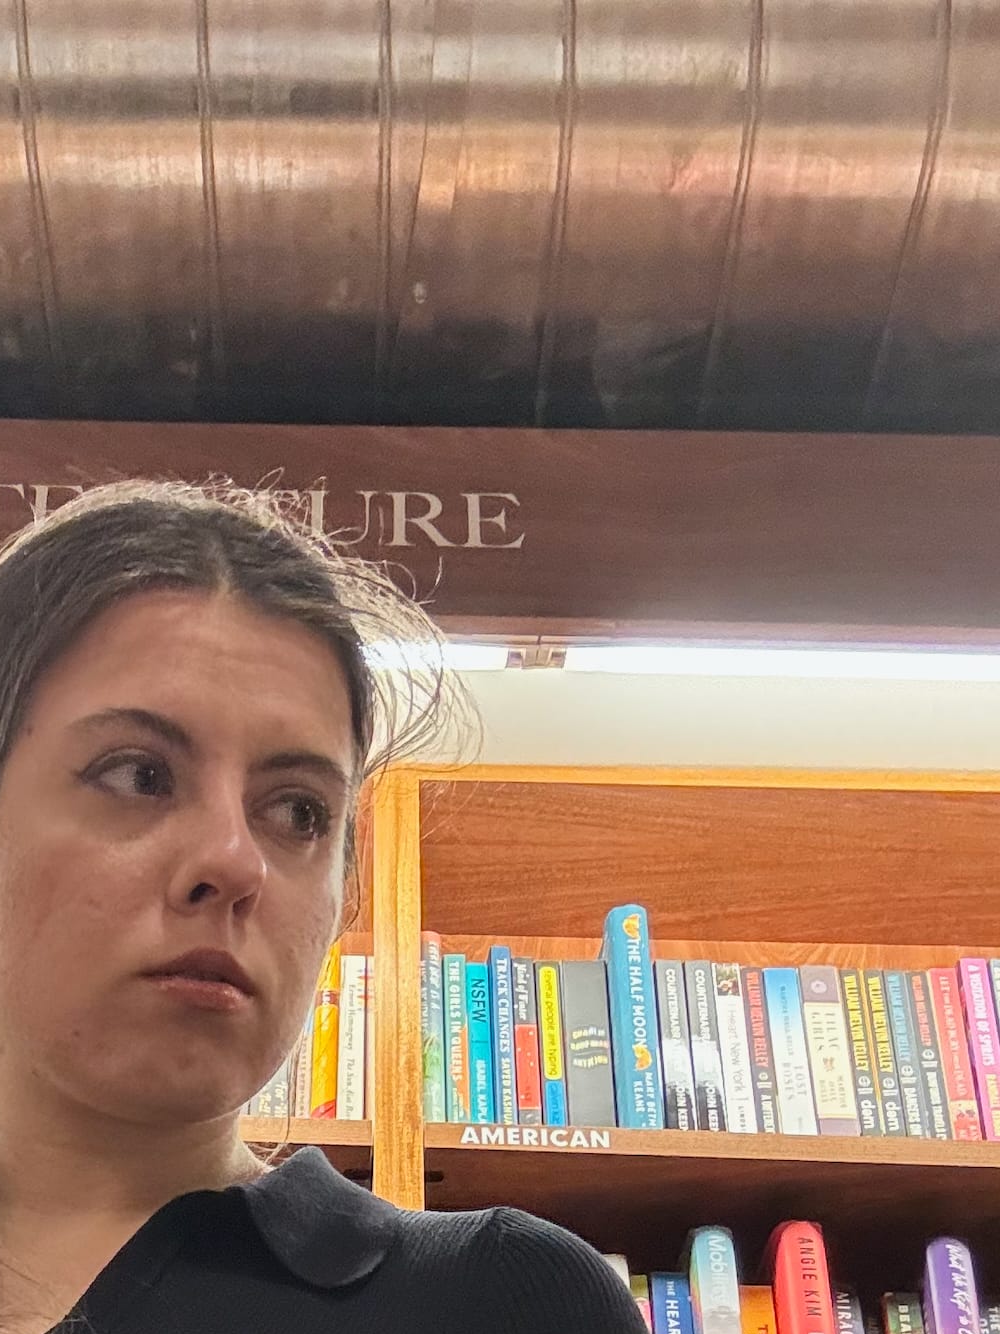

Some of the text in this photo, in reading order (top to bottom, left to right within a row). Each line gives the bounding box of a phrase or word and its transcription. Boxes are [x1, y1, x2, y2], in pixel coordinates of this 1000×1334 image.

[496, 958, 507, 995] TRACK
[627, 938, 648, 1048] THE HALF MOON
[471, 978, 487, 1023] NSFW
[448, 961, 463, 1081] THE GIRLS IN QUEENS
[852, 1041, 869, 1072] KELLEY
[877, 1040, 894, 1074] KELLEY
[978, 1033, 996, 1066] SPIRITS
[460, 1126, 611, 1149] AMERICAN
[799, 1236, 822, 1282] ANGIE
[667, 1280, 678, 1297] THE
[803, 1290, 822, 1318] KIM
